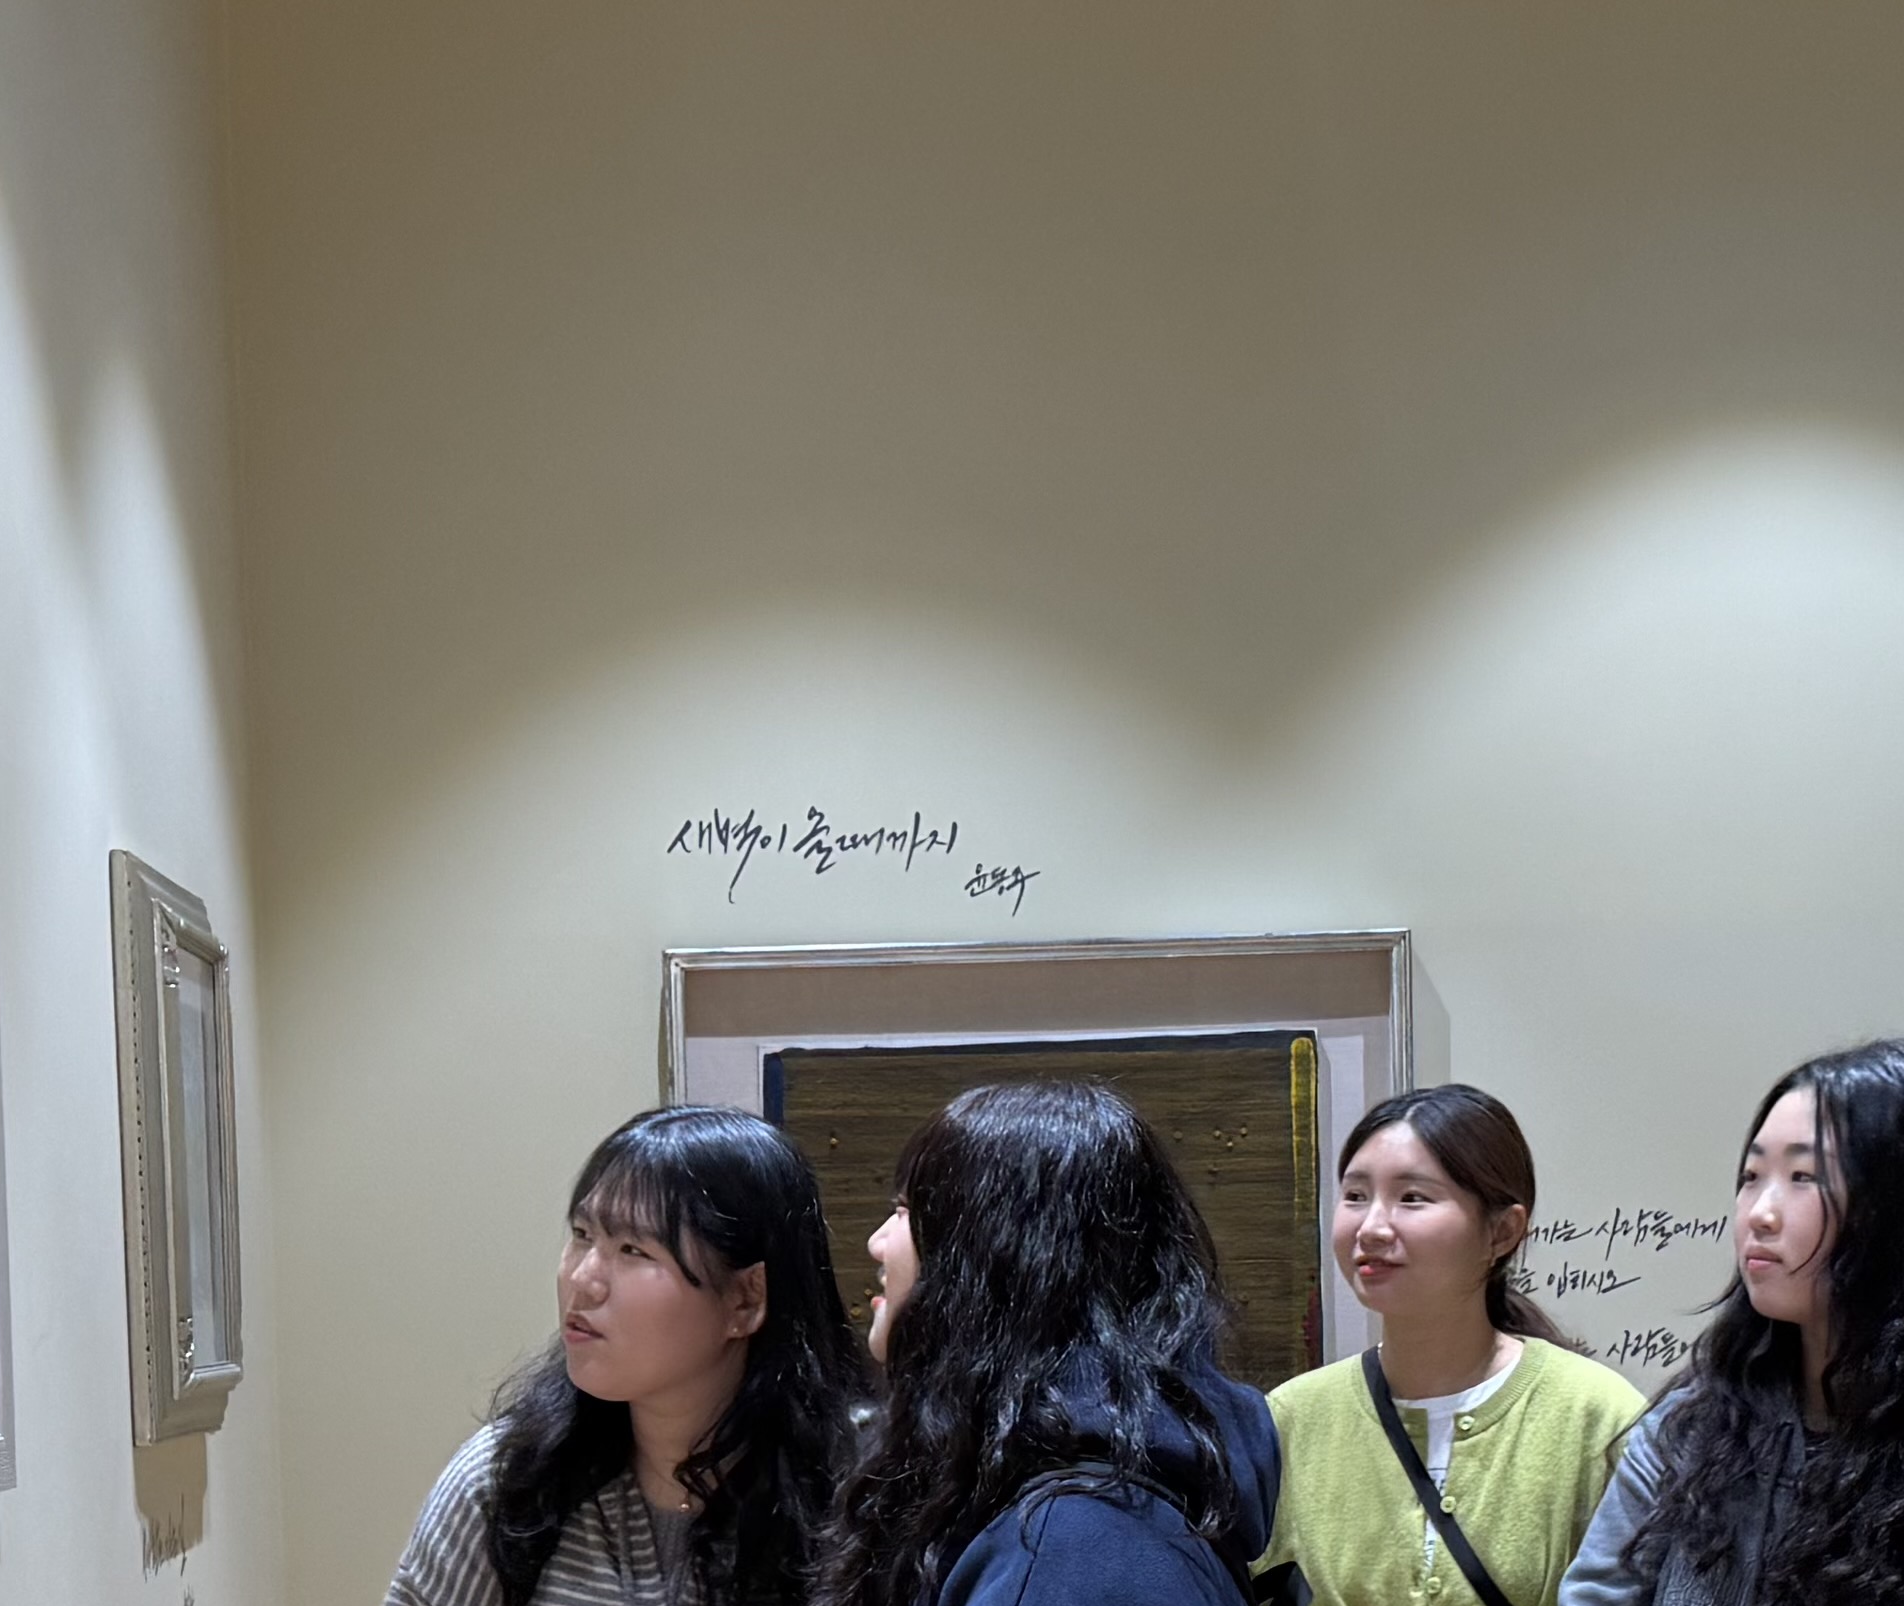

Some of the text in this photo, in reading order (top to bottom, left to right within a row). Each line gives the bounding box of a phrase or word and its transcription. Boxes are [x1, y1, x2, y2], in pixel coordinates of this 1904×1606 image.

[667, 808, 787, 904] 새벽이
[1595, 1207, 1729, 1262] 사람들에게
[1547, 1261, 1642, 1299] 입히시오
